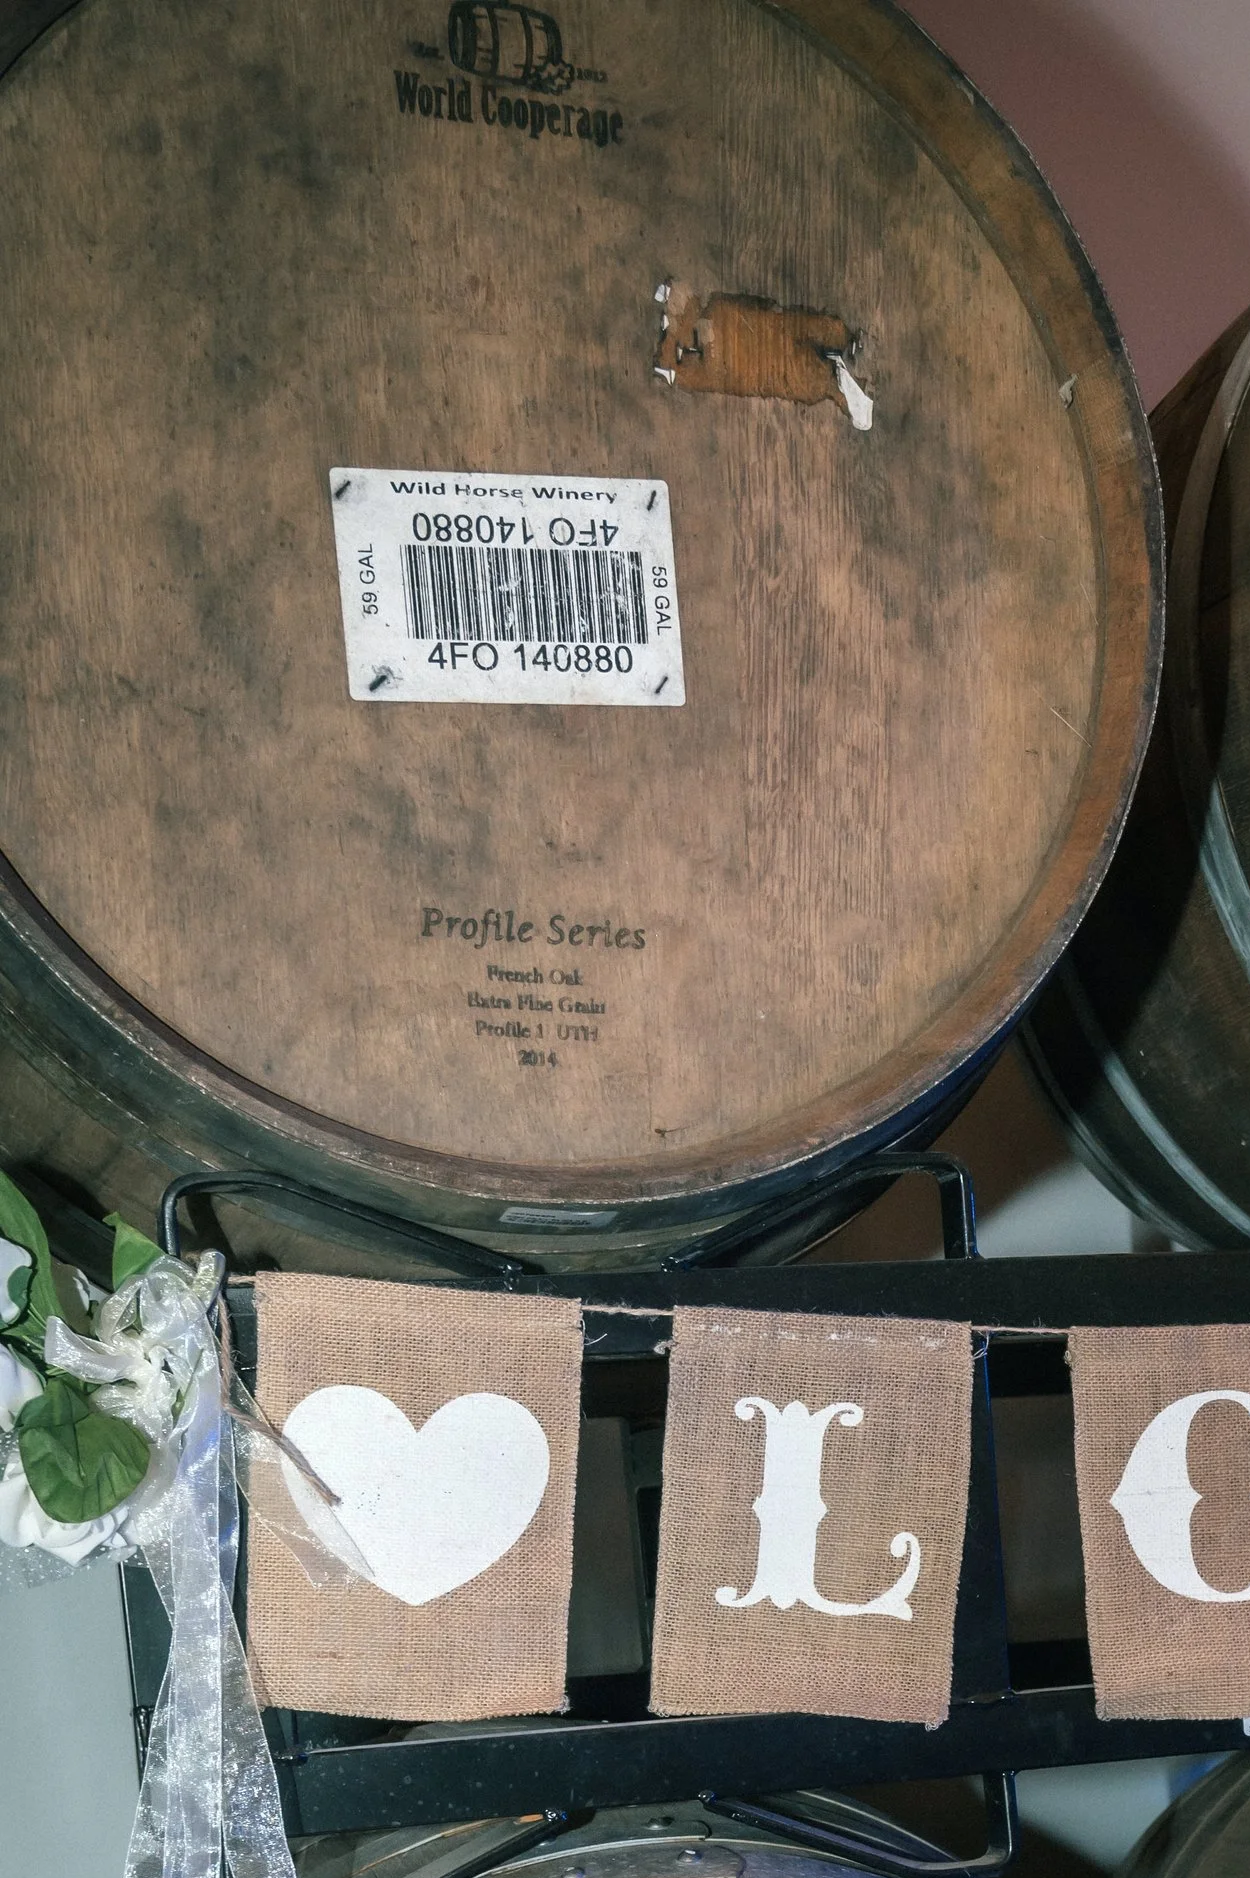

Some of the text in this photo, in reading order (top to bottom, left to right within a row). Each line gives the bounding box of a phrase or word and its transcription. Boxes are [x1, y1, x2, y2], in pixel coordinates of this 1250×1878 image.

[393, 69, 624, 149] World Cooperage
[390, 481, 619, 504] Wild Horse Winery
[412, 512, 620, 547] 4FO 140880
[358, 543, 379, 615] 59 GAL
[652, 566, 673, 636] 59 GAL
[428, 642, 633, 674] 4FO 140880
[421, 907, 646, 950] Profile Series
[487, 965, 583, 986] French Oak
[467, 992, 512, 1010] Extra
[518, 994, 553, 1013] Fine
[475, 1020, 531, 1038] Profile
[518, 1049, 557, 1068] 2014
